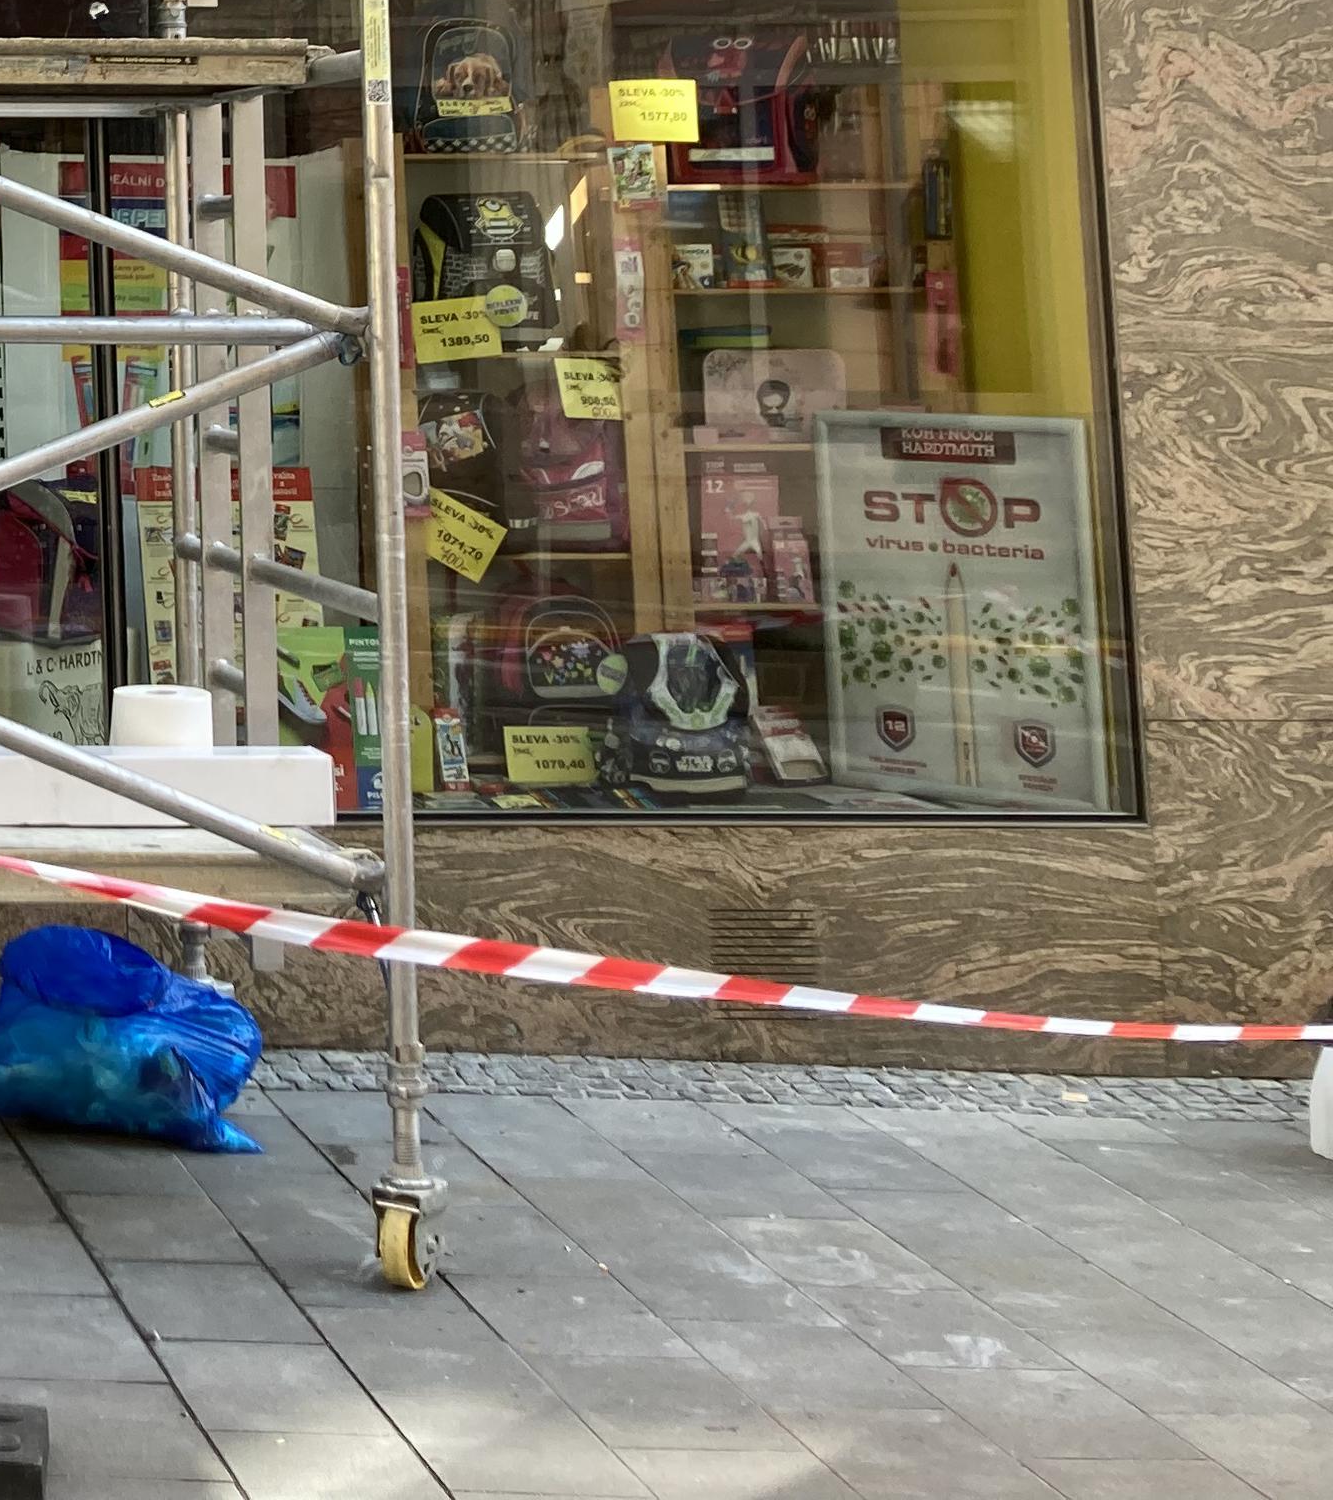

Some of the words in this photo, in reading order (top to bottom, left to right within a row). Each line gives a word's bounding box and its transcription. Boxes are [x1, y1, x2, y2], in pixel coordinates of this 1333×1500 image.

[619, 88, 657, 97] SLEVA
[639, 111, 687, 122] 1577,80
[420, 313, 459, 324] SLEVA
[440, 334, 490, 348] 1389,50
[901, 441, 997, 459] HARDTMUTH
[705, 479, 725, 494] 12
[431, 497, 467, 524] SLEVA
[436, 528, 484, 562] 1071,70
[865, 536, 924, 552] virus
[942, 538, 1045, 560] bacteria
[885, 719, 906, 732] 12
[512, 734, 550, 744] SLEVA
[535, 759, 586, 770] 1079,40
